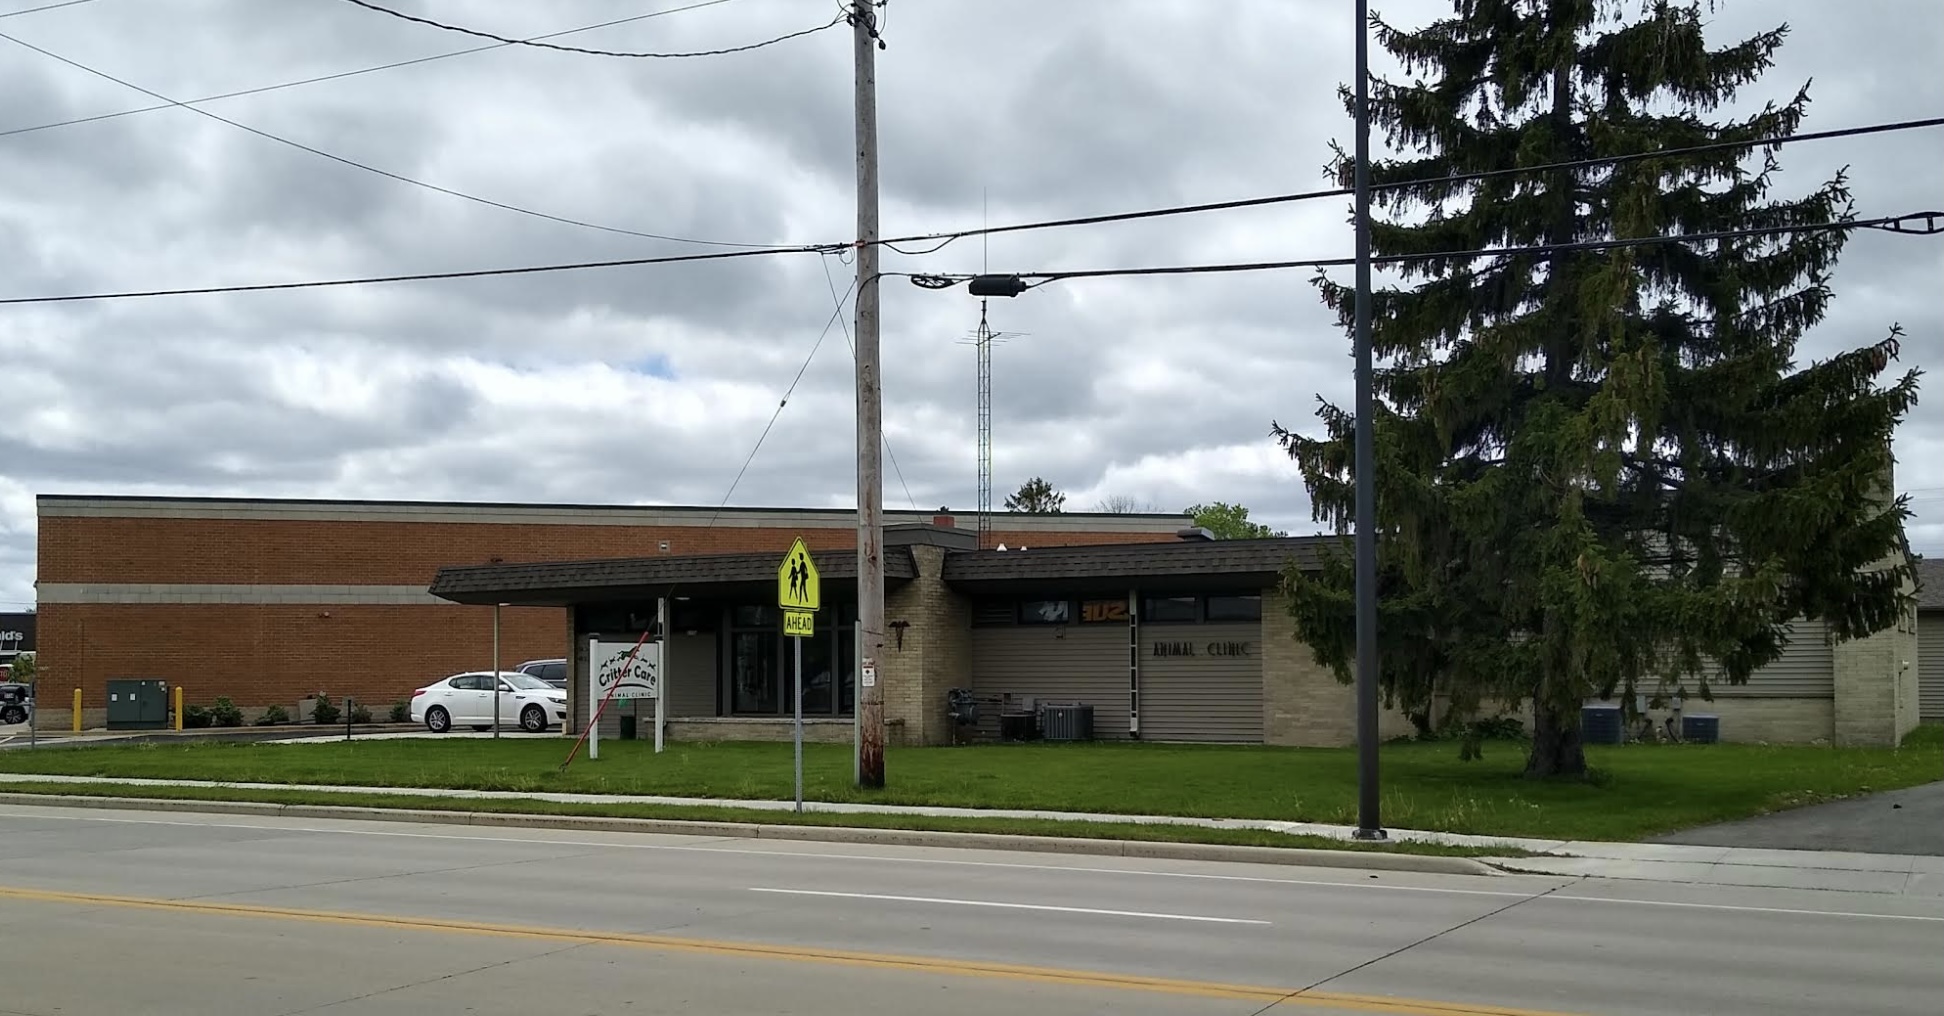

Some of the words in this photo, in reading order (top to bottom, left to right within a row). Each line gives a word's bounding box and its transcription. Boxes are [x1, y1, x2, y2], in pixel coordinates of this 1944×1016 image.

[786, 616, 812, 631] AHEAD
[0, 630, 23, 641] ld's
[1153, 641, 1195, 657] ANIMAL
[1207, 641, 1252, 656] CLINIC
[599, 667, 632, 687] Critter
[634, 665, 656, 686] Care
